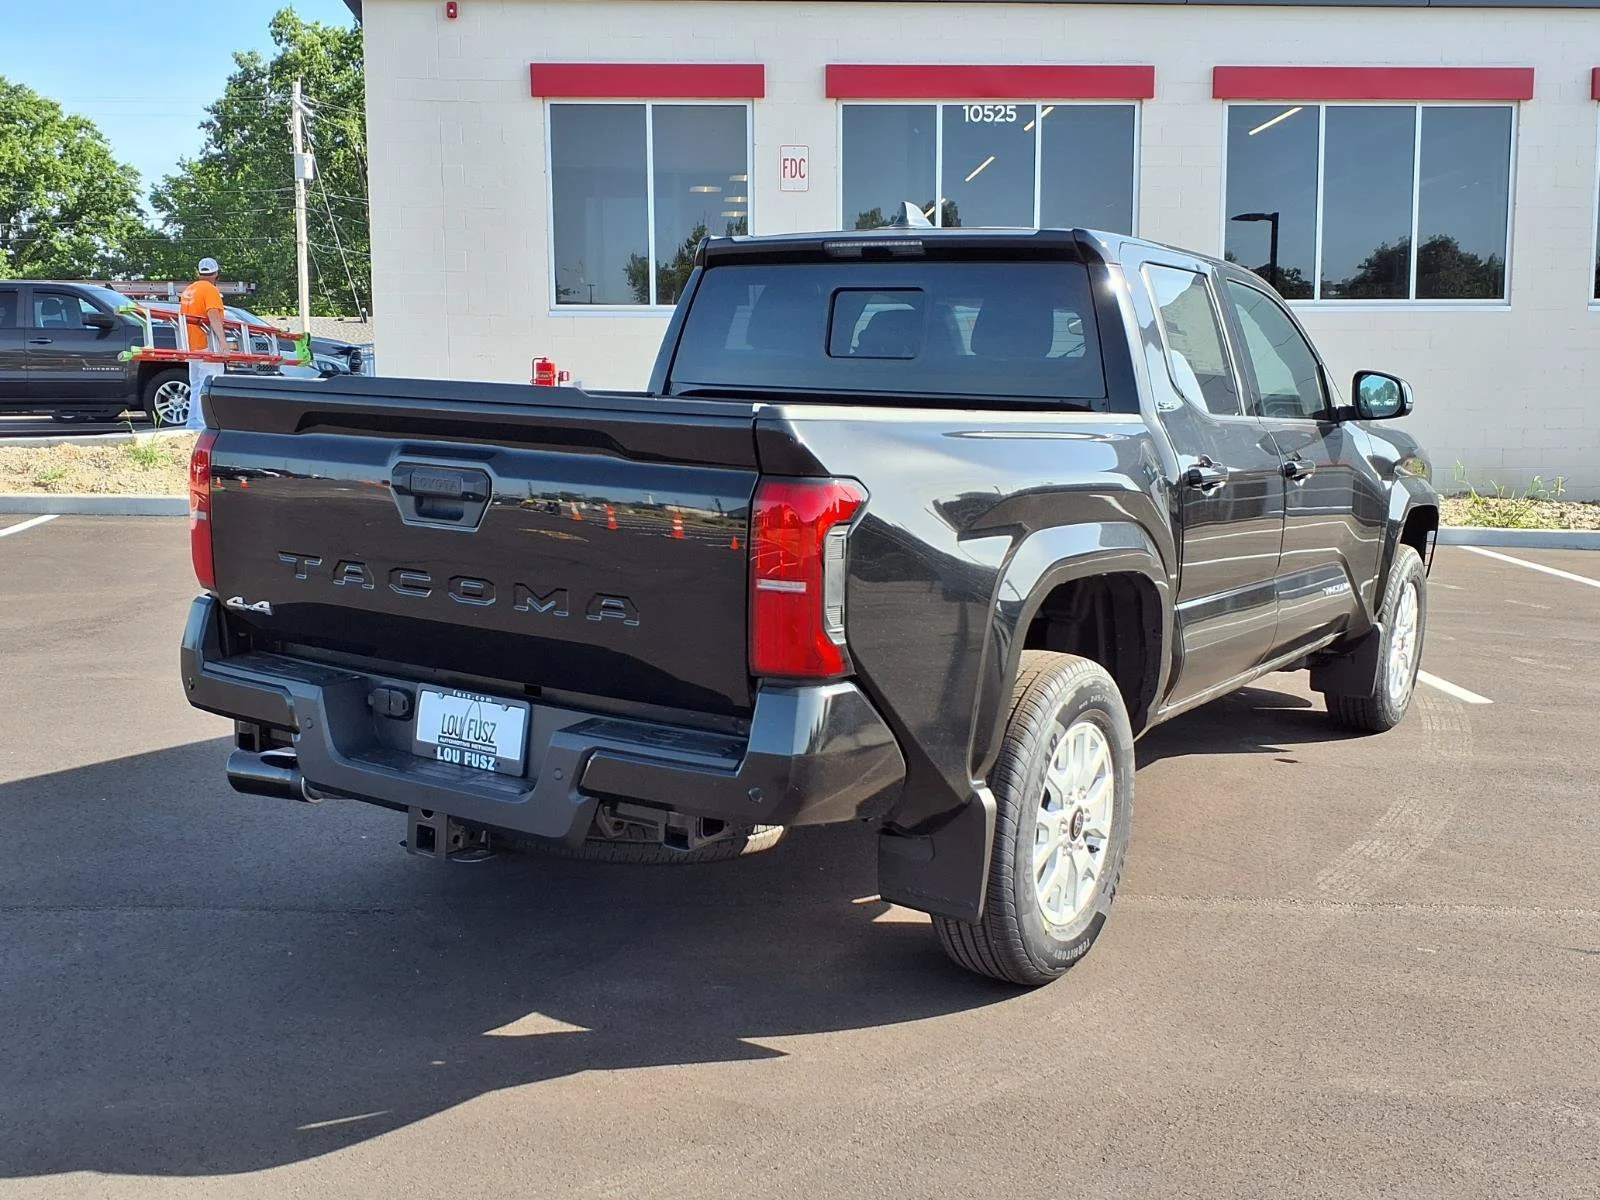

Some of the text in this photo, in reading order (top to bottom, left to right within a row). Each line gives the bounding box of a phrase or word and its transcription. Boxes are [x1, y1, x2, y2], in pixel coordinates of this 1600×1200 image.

[962, 105, 1018, 123] 10525
[782, 157, 807, 180] FDC
[277, 550, 641, 627] TACOMA
[441, 713, 497, 745] LOU FUSZ
[436, 746, 496, 771] LOU FUSZ
